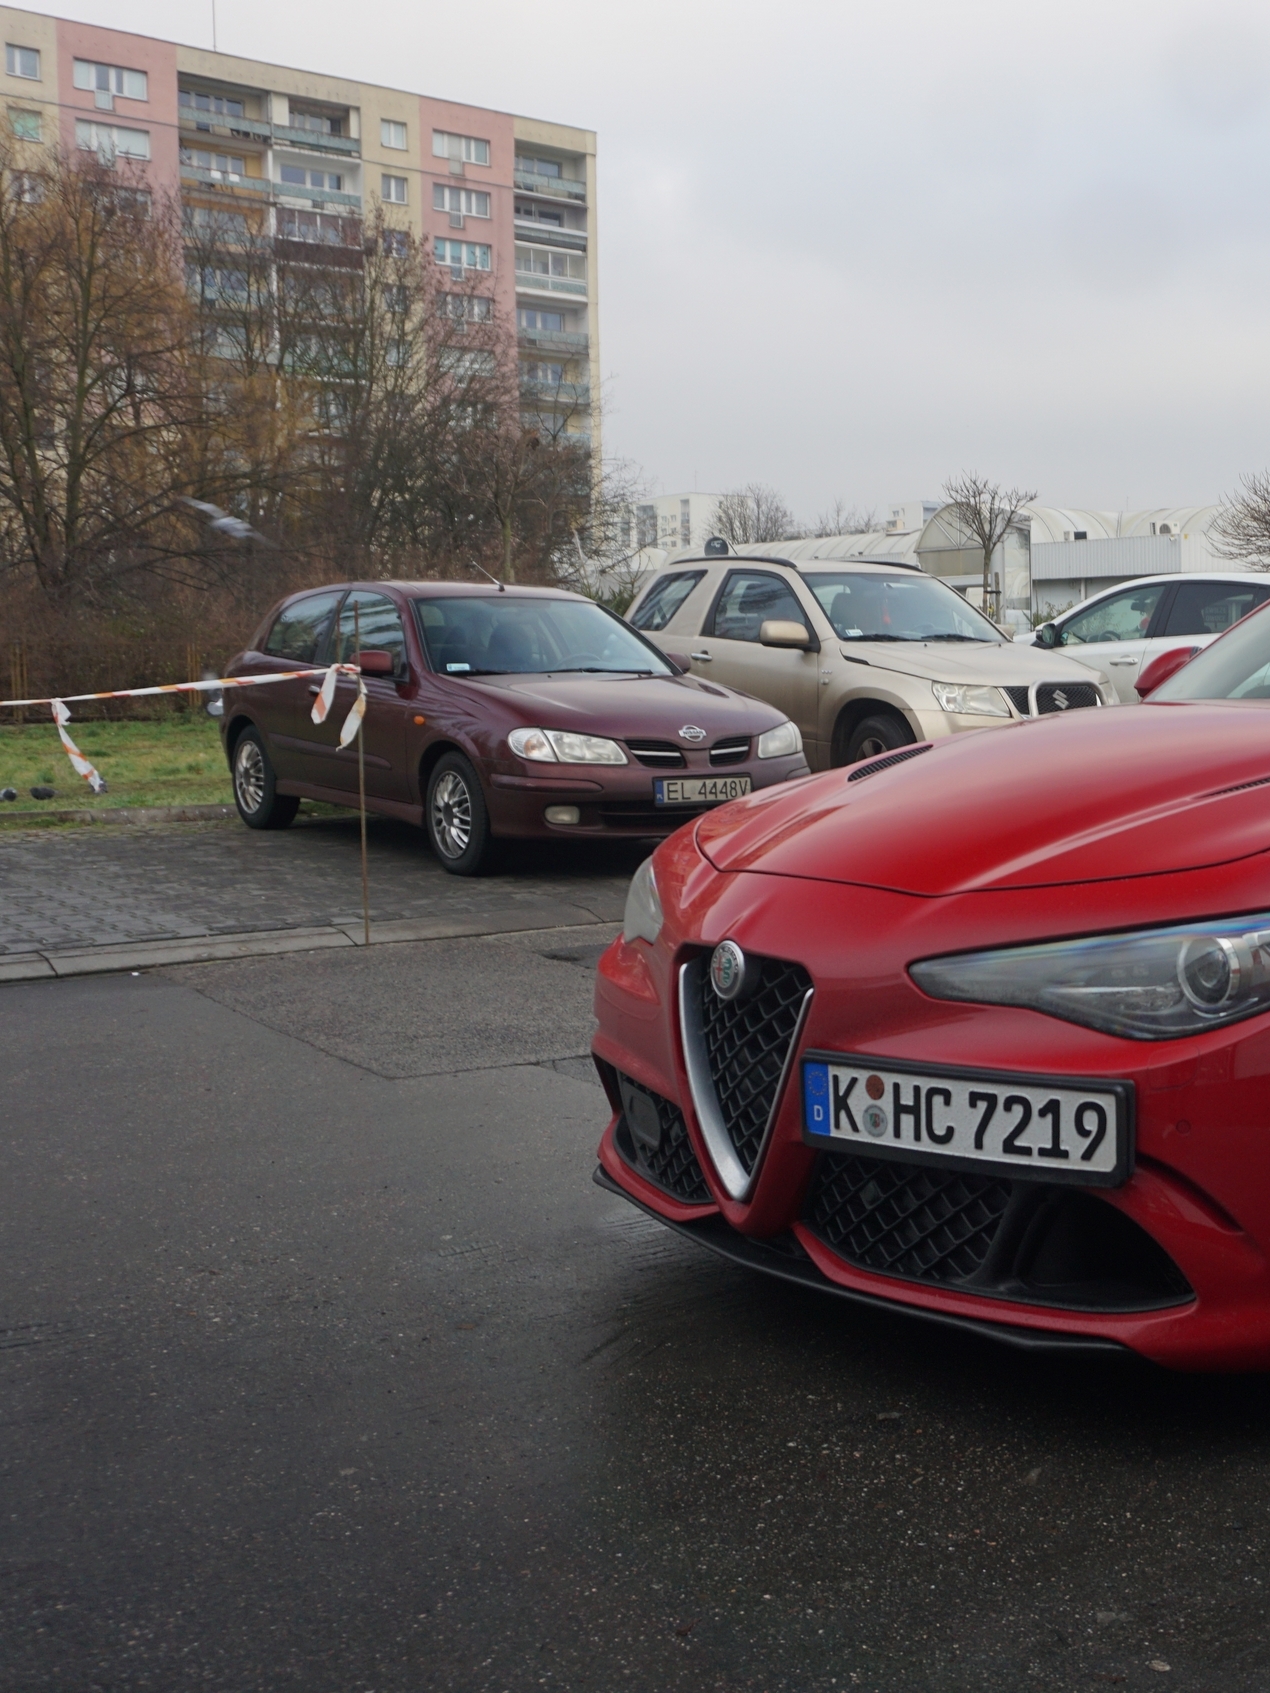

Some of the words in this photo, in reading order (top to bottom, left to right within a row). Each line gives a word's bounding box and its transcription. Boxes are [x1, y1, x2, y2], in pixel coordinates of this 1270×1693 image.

[667, 782, 691, 800] EL
[698, 779, 748, 799] 4448V
[813, 1104, 824, 1122] D
[832, 1074, 860, 1133] K
[892, 1082, 955, 1145] HC
[968, 1091, 1108, 1161] 7219
